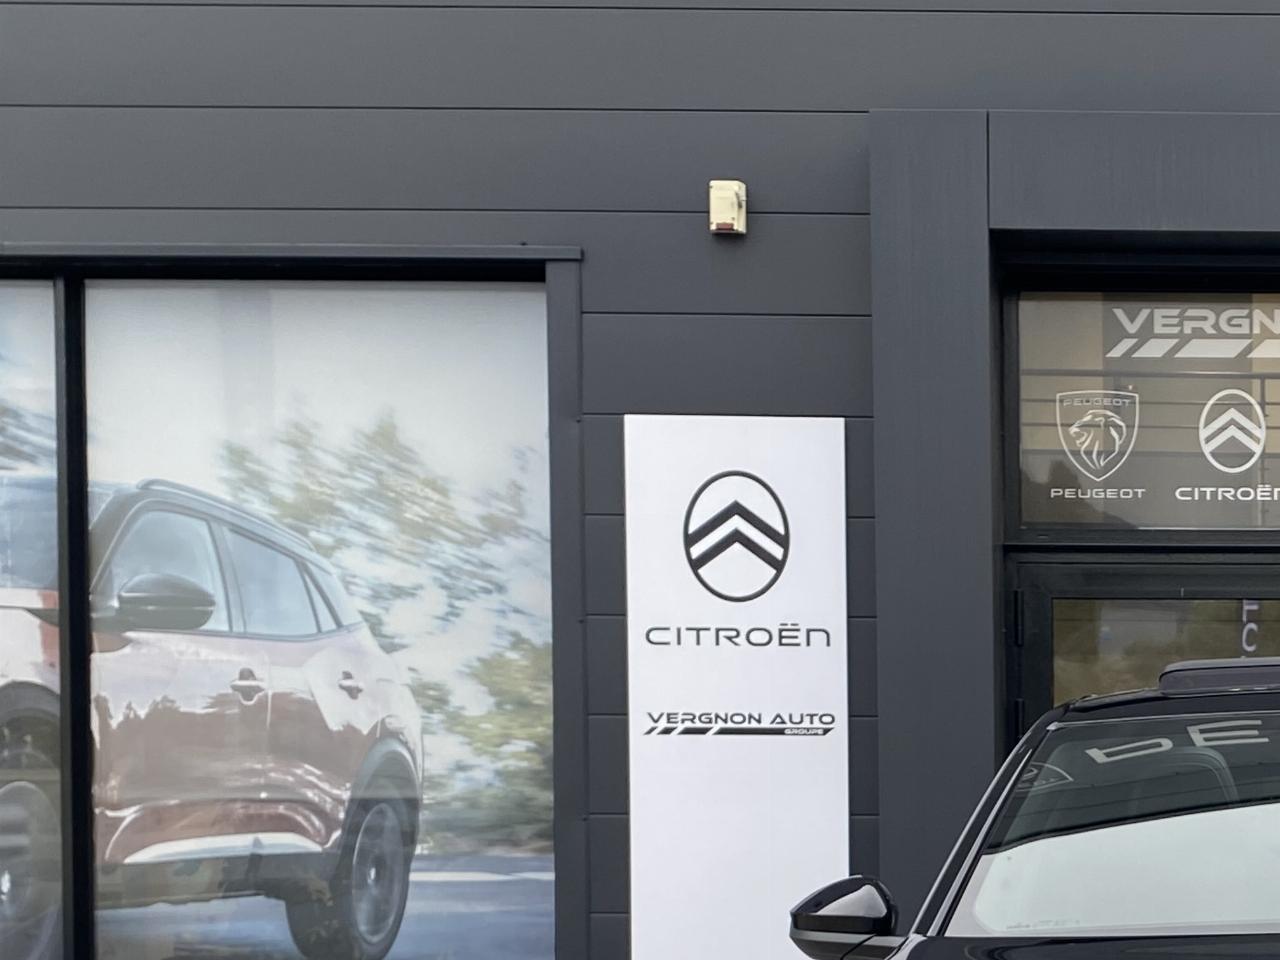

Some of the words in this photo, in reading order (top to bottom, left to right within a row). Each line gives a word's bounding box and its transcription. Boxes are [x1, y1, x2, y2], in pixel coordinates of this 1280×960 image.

[1063, 397, 1132, 407] PEUGEOT
[1050, 488, 1146, 499] PEUGEOT
[647, 712, 762, 725] VERGNON
[770, 713, 836, 725] AUTO
